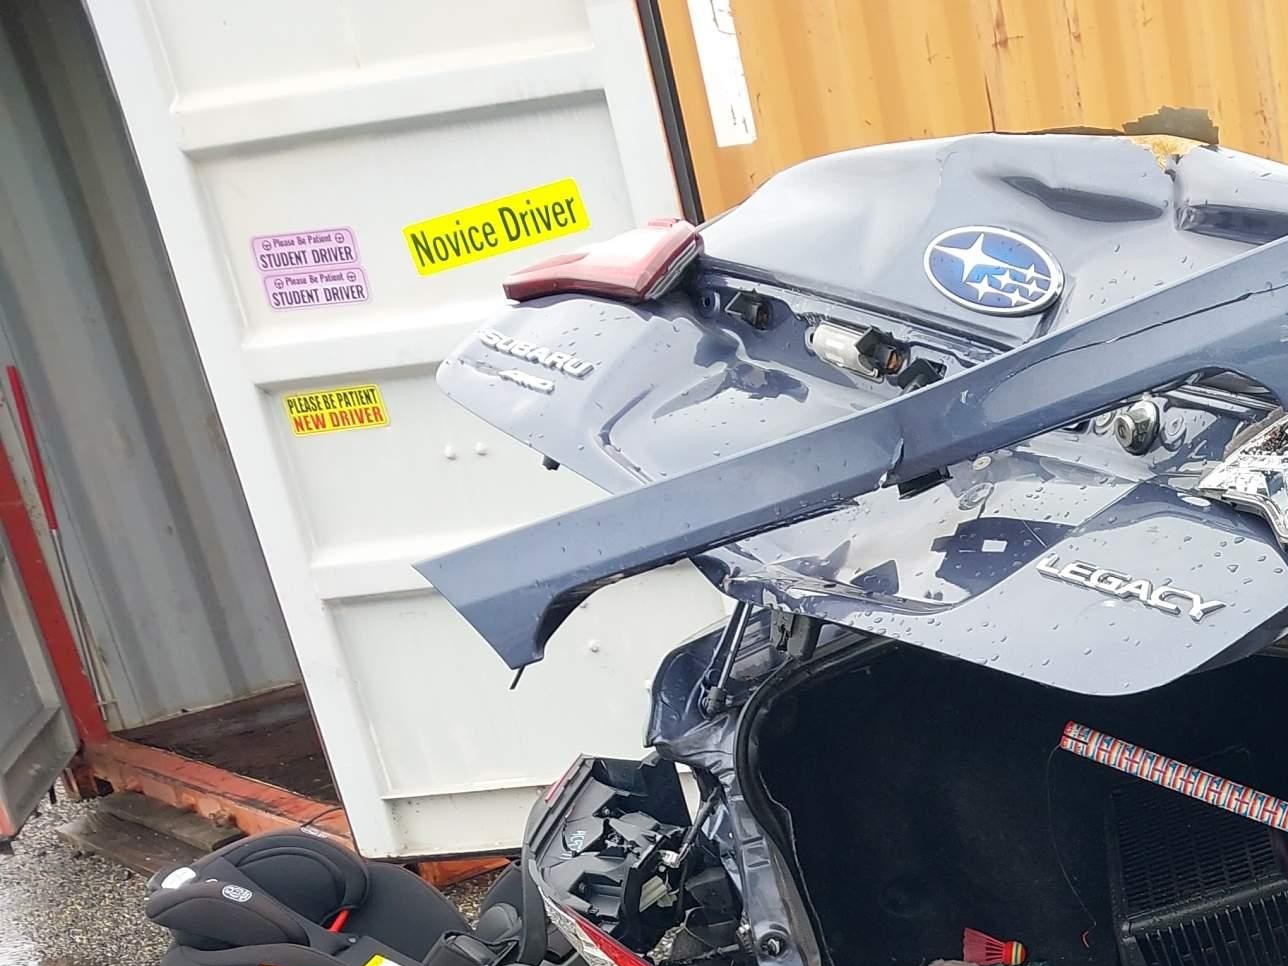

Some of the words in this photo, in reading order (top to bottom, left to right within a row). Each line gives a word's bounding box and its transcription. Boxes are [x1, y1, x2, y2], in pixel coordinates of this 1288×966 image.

[272, 238, 295, 248] Please
[296, 236, 306, 245] Be
[307, 234, 332, 244] Patient
[410, 220, 499, 267] Novice
[498, 197, 577, 242] Driver
[260, 249, 309, 269] STUDENT
[311, 245, 354, 264] DRIVER
[285, 276, 307, 286] Please
[309, 275, 319, 284] Be
[320, 272, 345, 282] Patient
[272, 288, 320, 307] STUDENT
[323, 284, 366, 302] DRIVER
[479, 328, 595, 381] SUBARU
[287, 396, 323, 415] PLEASE
[322, 393, 337, 410] BE
[336, 388, 378, 408] PATIENT
[293, 412, 327, 432] NEW
[329, 405, 384, 428] DRIVER
[1036, 552, 1227, 623] LEGACY
